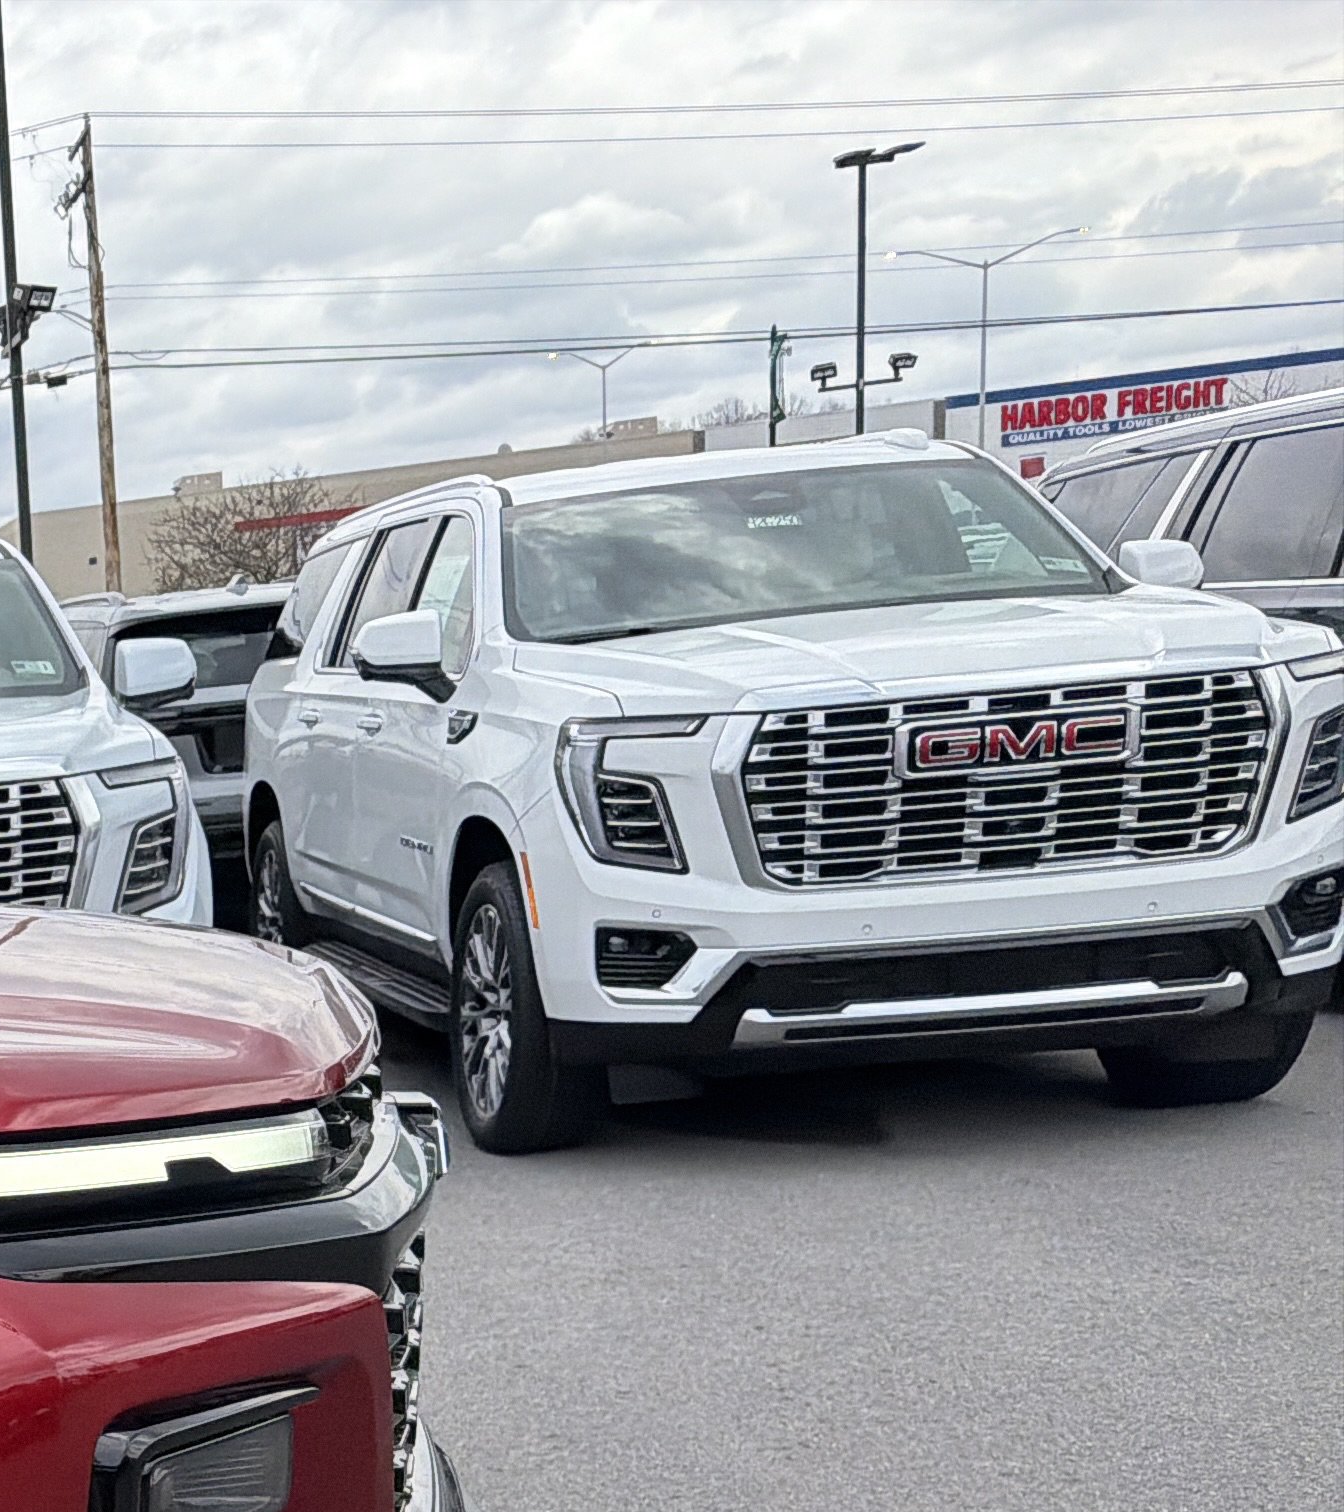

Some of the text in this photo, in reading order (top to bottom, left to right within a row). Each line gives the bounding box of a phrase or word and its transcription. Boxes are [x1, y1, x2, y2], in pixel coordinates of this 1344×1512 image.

[1000, 378, 1229, 433] HARBOR FREIGHT
[1008, 427, 1066, 445] QUALITY
[1068, 422, 1110, 438] TOOLS
[1118, 415, 1171, 431] LOWEST
[916, 714, 1126, 768] GMC
